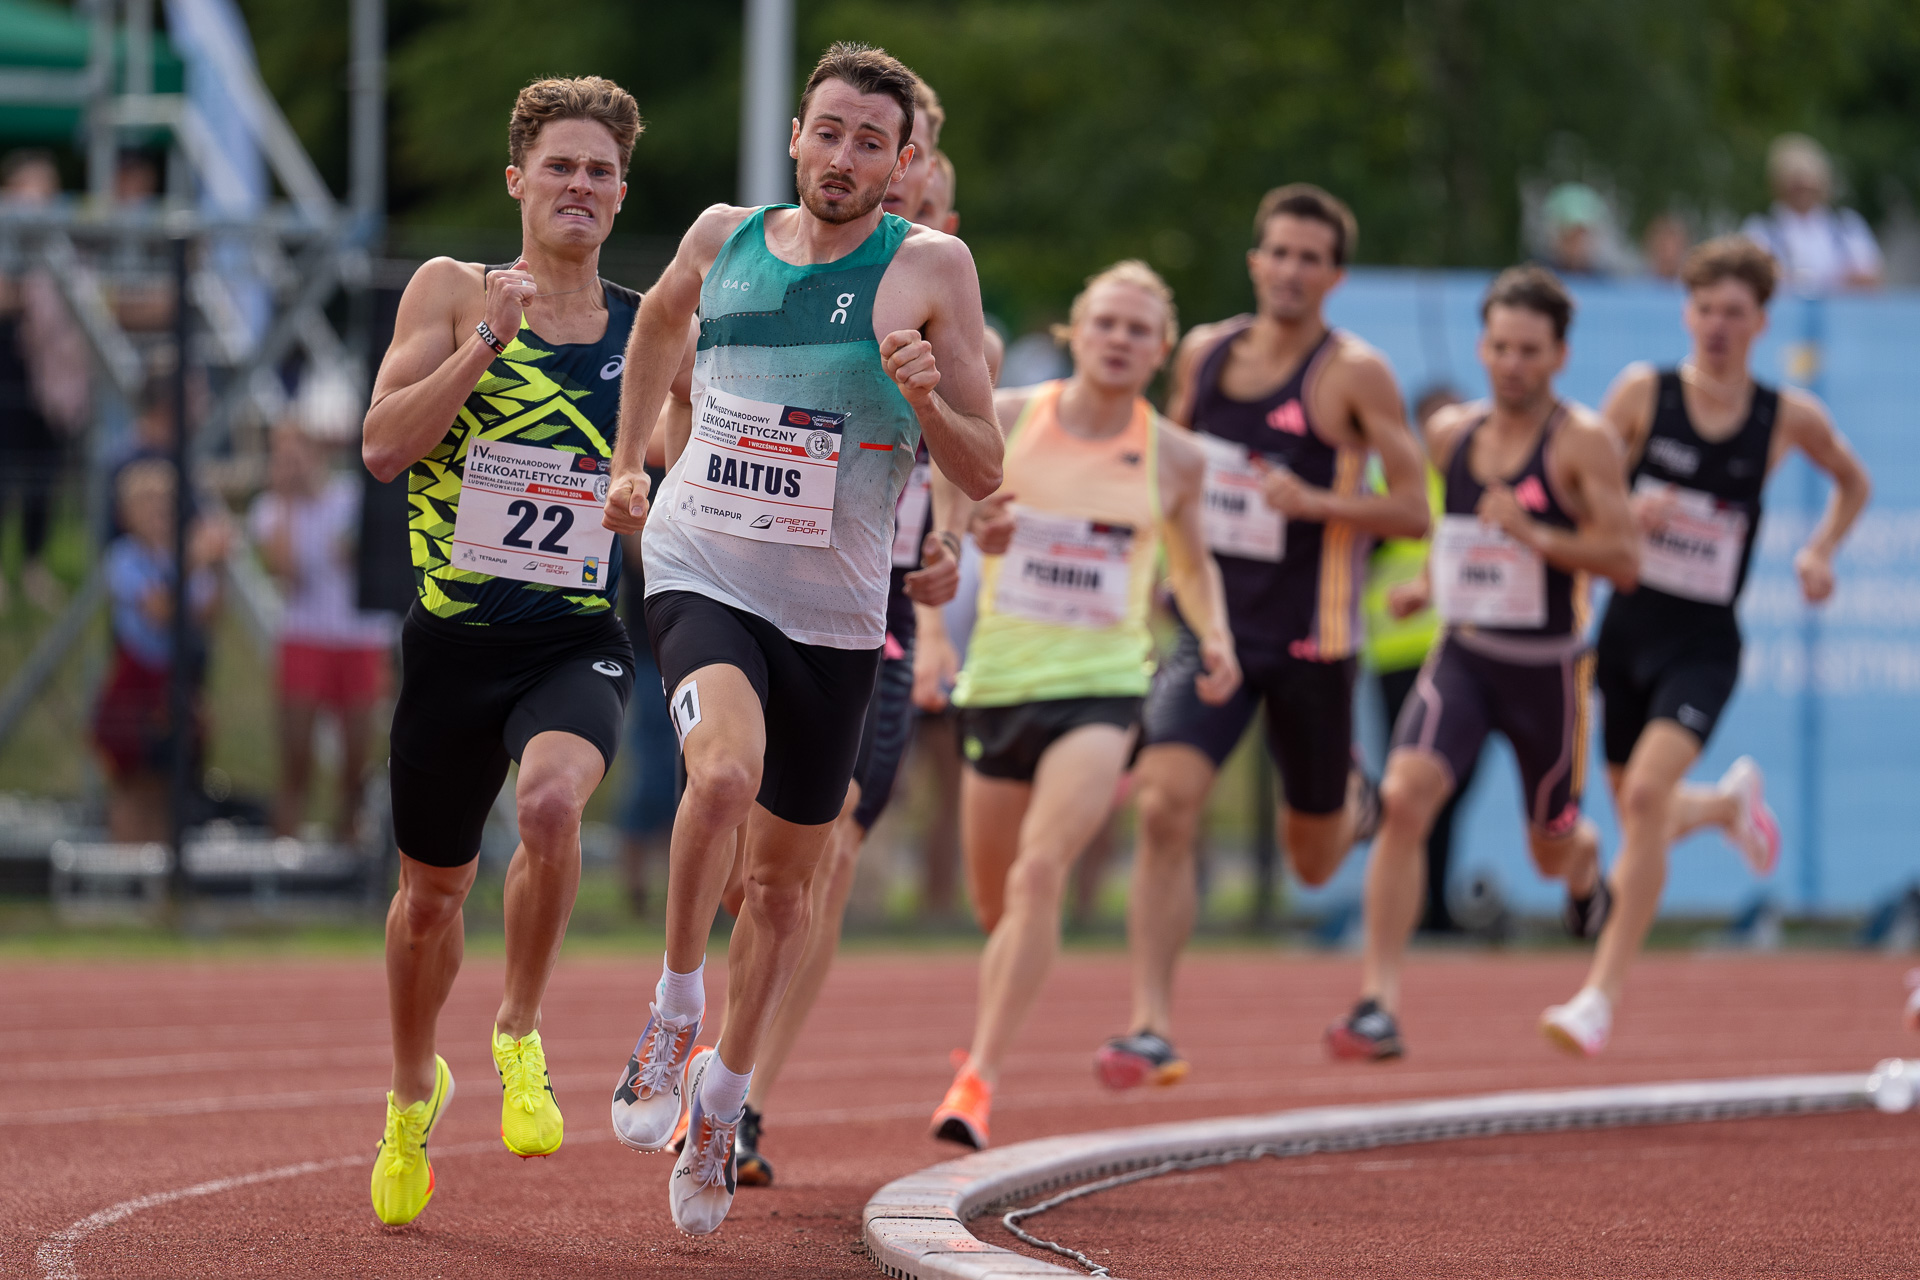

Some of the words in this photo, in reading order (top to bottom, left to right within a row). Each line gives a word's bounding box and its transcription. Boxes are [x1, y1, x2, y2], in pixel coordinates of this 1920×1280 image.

[722, 279, 751, 292] OAC
[705, 395, 717, 410] IV
[713, 404, 770, 424] MIĘDZYNARODOWY
[702, 411, 798, 442] LEKKOATLETYCZNY
[751, 441, 778, 452] WRZEŚNIA
[778, 446, 793, 454] 2024
[473, 445, 490, 458] IV
[487, 453, 562, 471] MIĘDZYNARODOWY
[470, 462, 587, 488] LEKKOATLETYCZNY
[707, 453, 802, 498] BALTUS
[468, 479, 525, 493] LUDWICHOWSKIEGO
[497, 478, 525, 487] ZBIGNIEWA
[541, 487, 569, 497] WRZEŚNIA
[569, 490, 583, 499] 2024
[700, 504, 742, 520] TETRAPUR
[502, 500, 575, 555] 22
[786, 525, 827, 536] SPORT
[479, 554, 508, 564] TETRAPUR
[545, 568, 570, 576] SPORT
